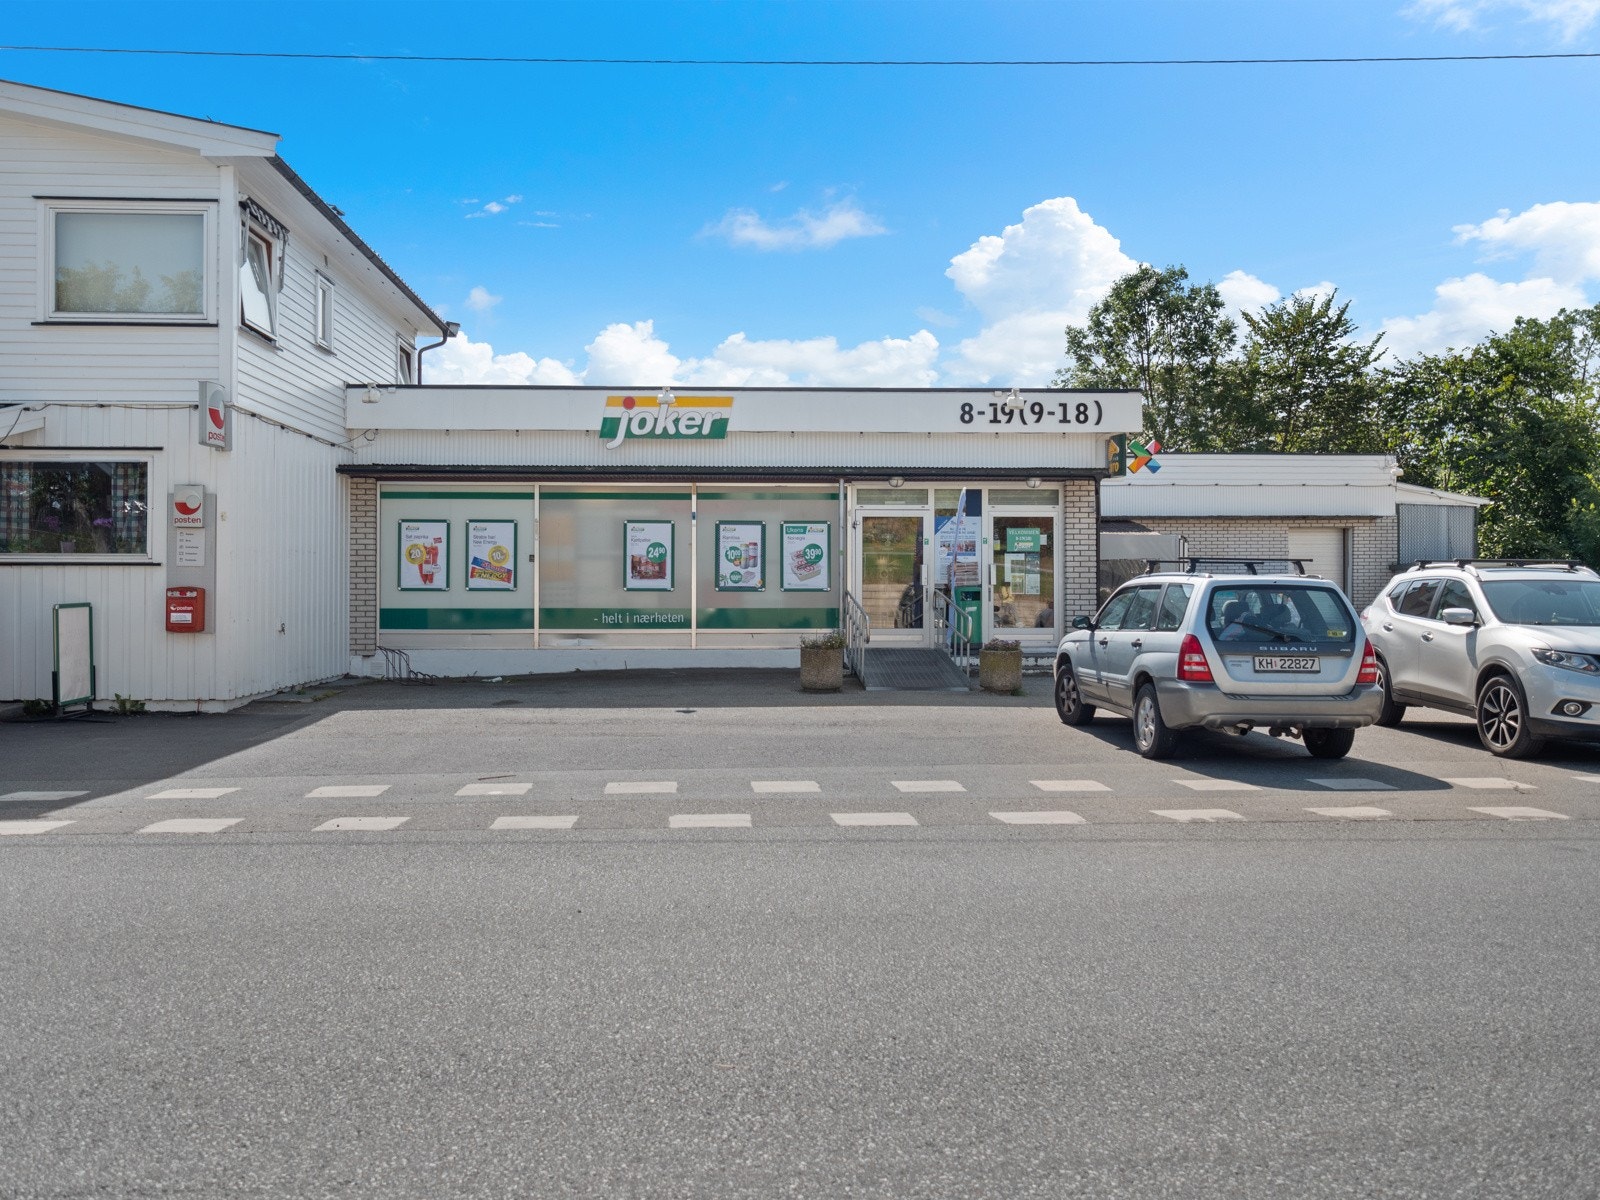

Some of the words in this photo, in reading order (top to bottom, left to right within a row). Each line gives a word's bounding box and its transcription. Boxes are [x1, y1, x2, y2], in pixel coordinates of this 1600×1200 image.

[959, 400, 1103, 425] 8-19(9-18)
[606, 397, 722, 450] joker
[174, 516, 202, 524] posten
[602, 613, 623, 624] helt
[633, 612, 684, 624] nærheten
[1258, 658, 1273, 669] KH
[1280, 659, 1315, 669] 22827
